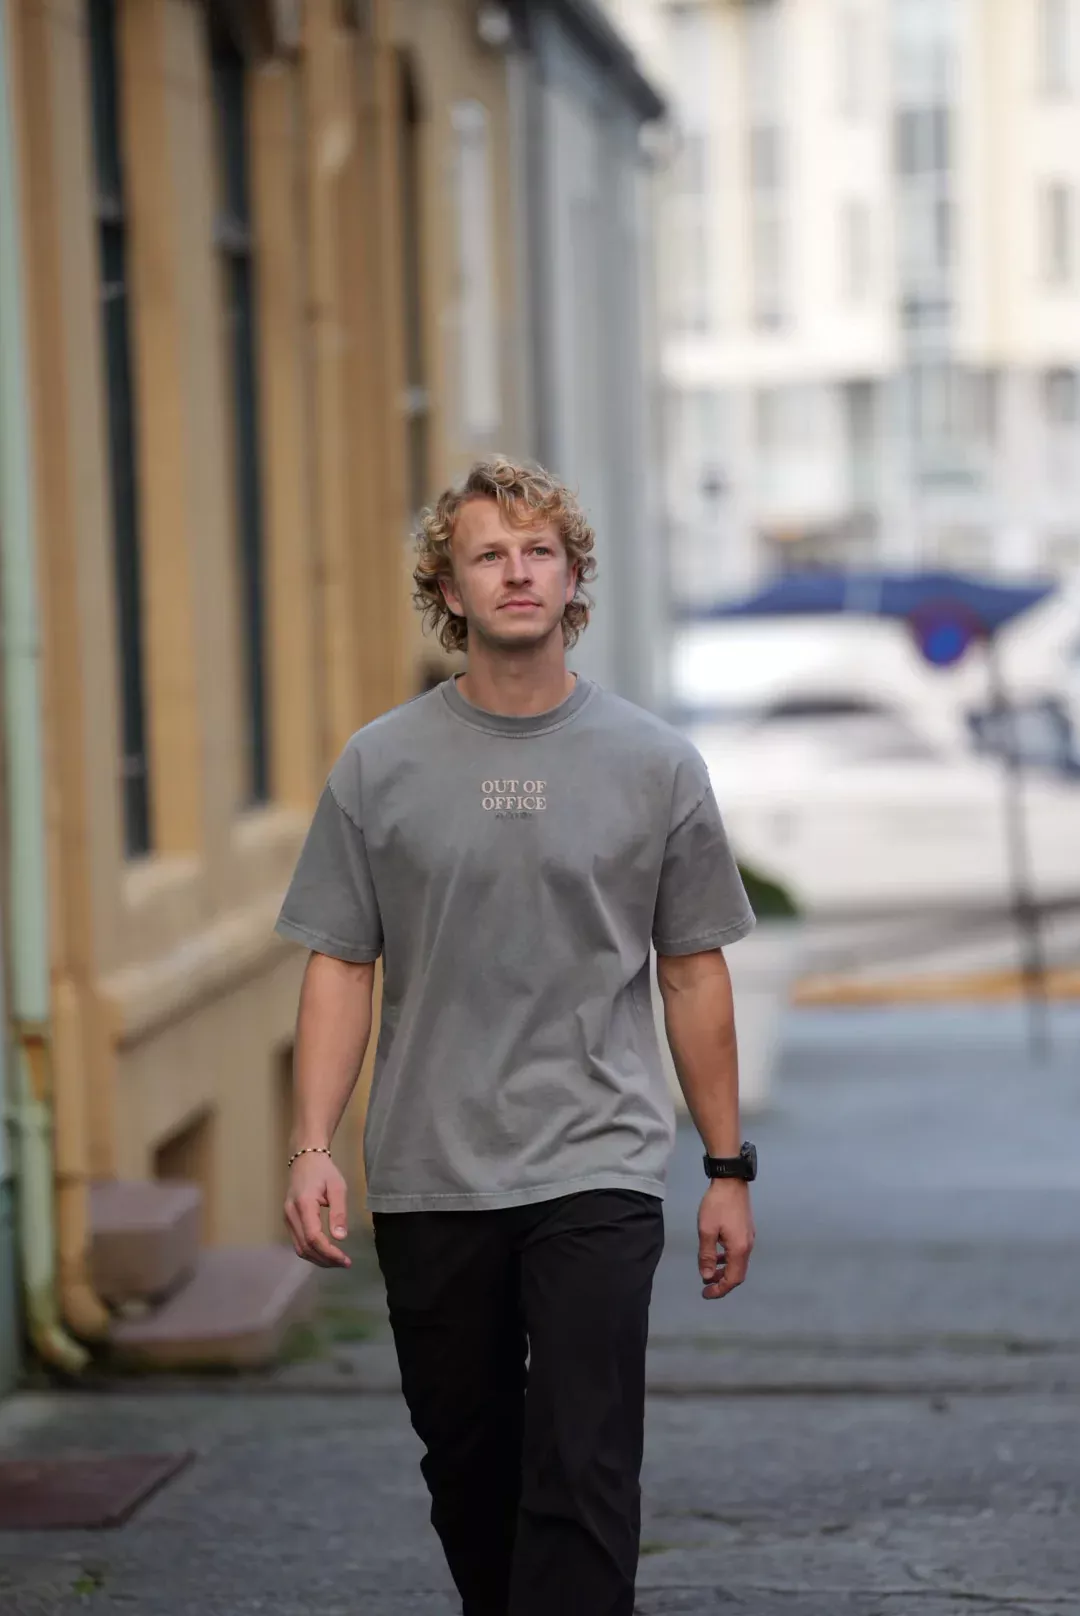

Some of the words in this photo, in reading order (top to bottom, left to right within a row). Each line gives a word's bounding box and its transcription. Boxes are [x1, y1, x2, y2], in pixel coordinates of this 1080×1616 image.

[481, 780, 519, 793] OUT
[523, 780, 547, 793] OF
[482, 796, 547, 810] OFFICE
